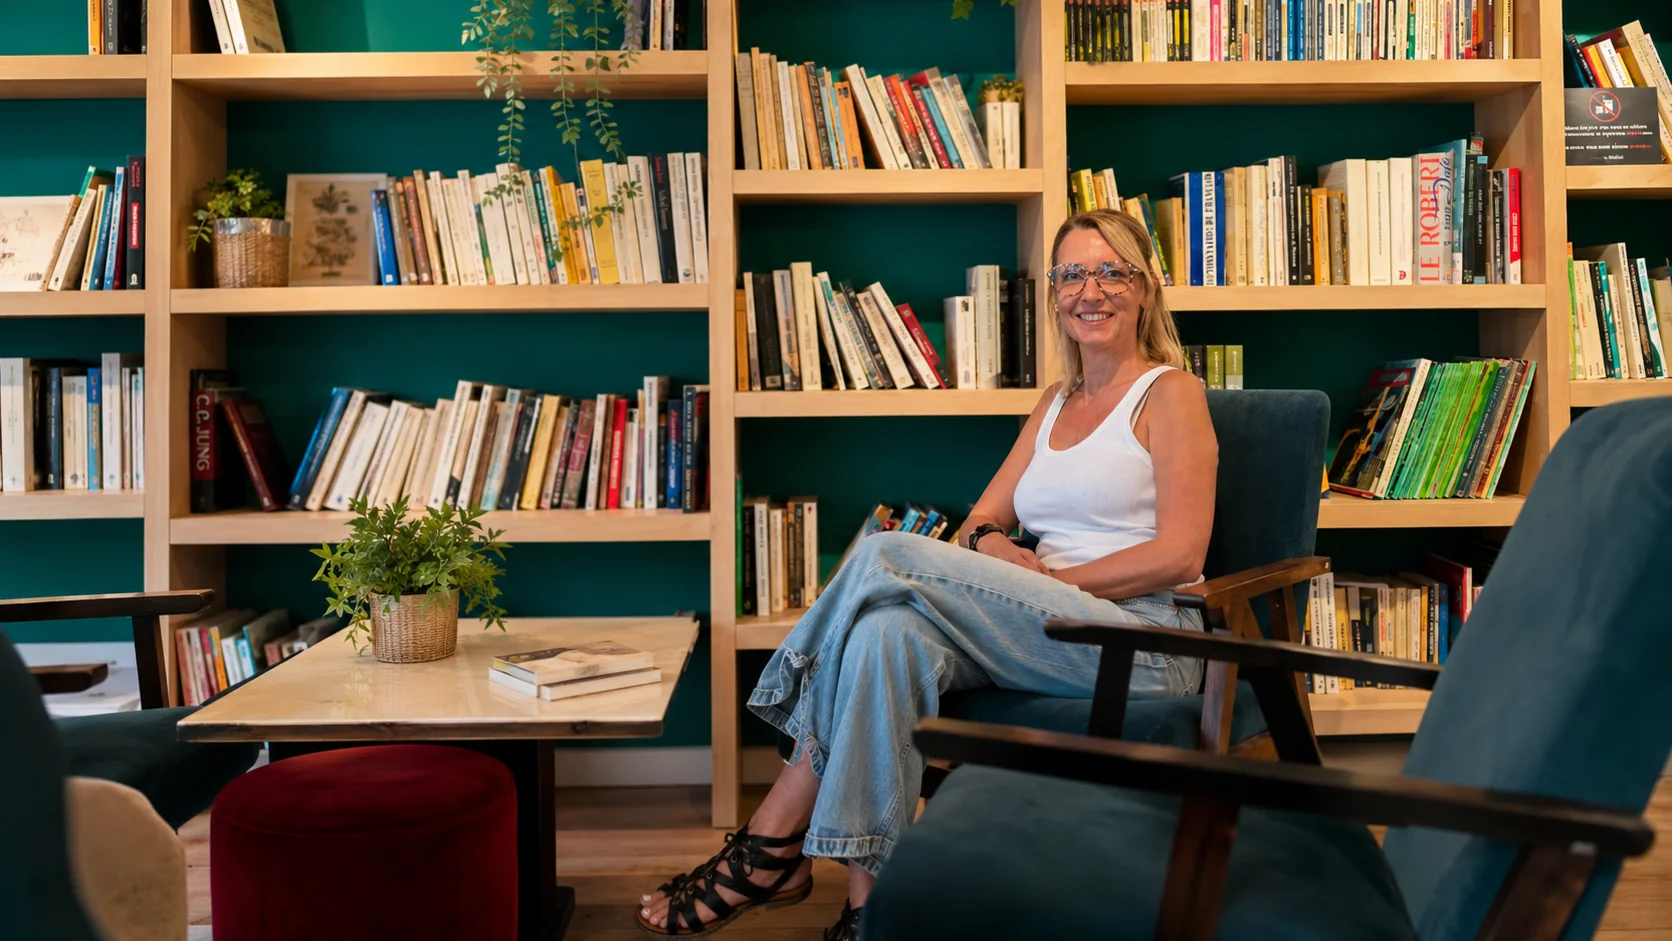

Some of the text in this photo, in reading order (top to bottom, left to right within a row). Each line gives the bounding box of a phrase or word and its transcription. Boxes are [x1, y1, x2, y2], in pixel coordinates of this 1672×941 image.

[1420, 156, 1440, 281] LE ROBERT
[196, 426, 210, 471] JUNG
